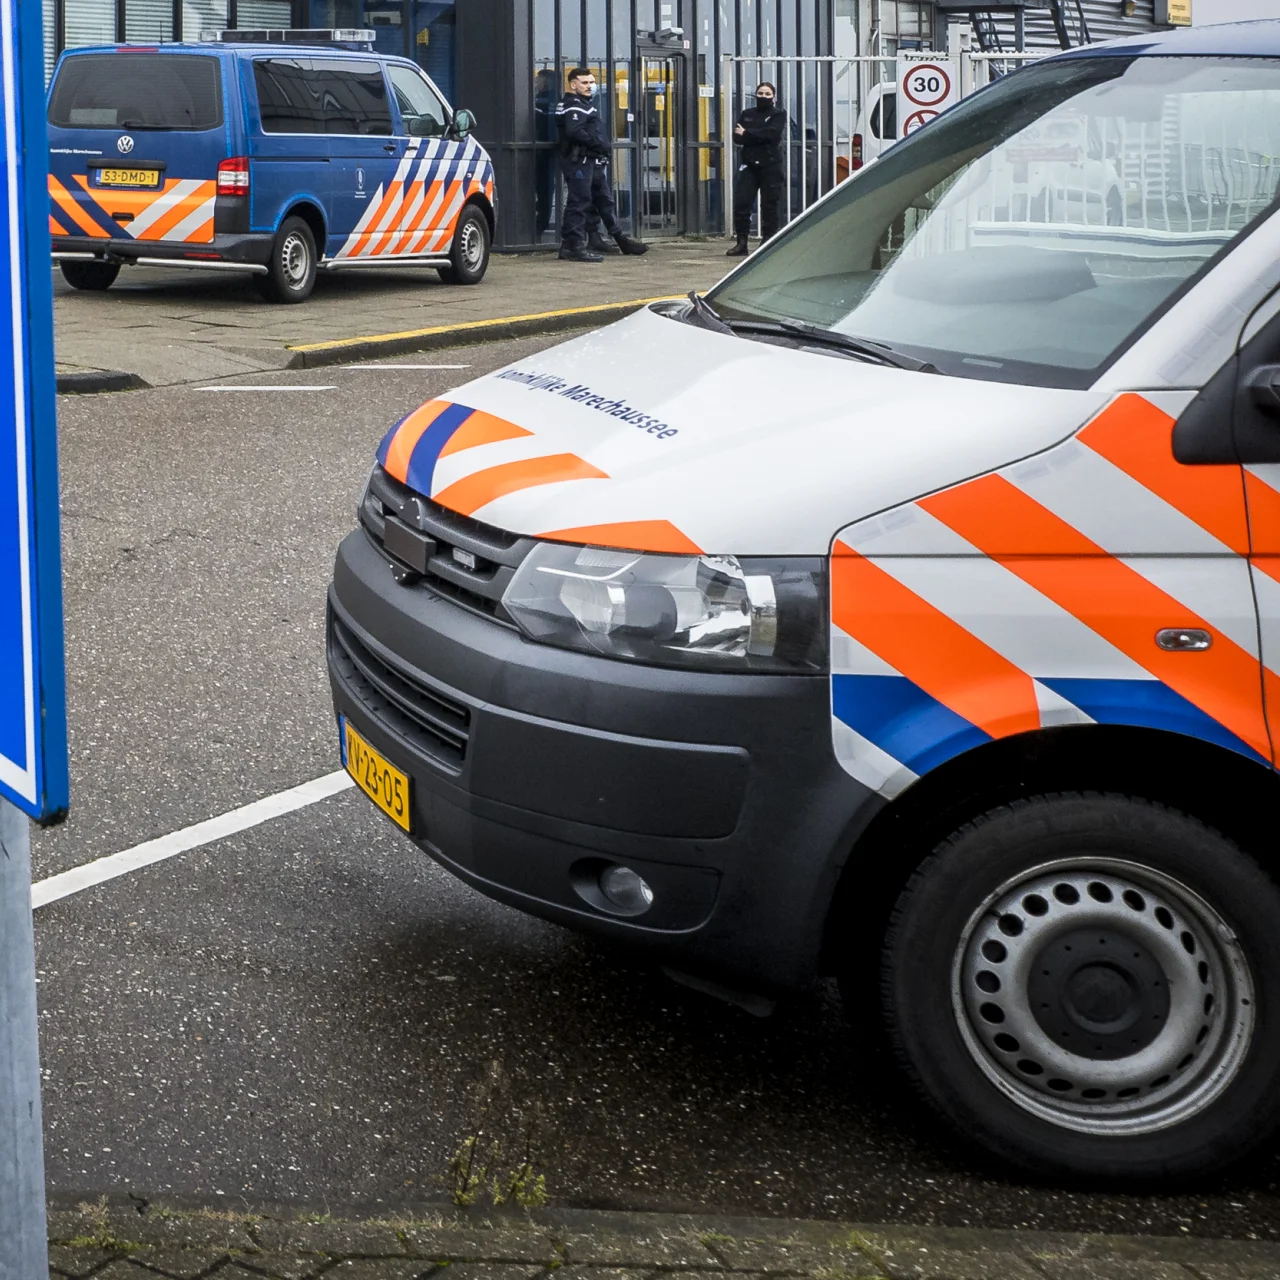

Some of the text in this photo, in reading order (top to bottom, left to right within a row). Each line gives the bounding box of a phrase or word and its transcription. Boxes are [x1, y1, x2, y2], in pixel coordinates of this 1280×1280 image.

[913, 76, 940, 93] 30
[104, 170, 155, 183] 53-DMD-1
[557, 384, 679, 439] Marechaussee
[347, 728, 404, 817] KV-23-05
